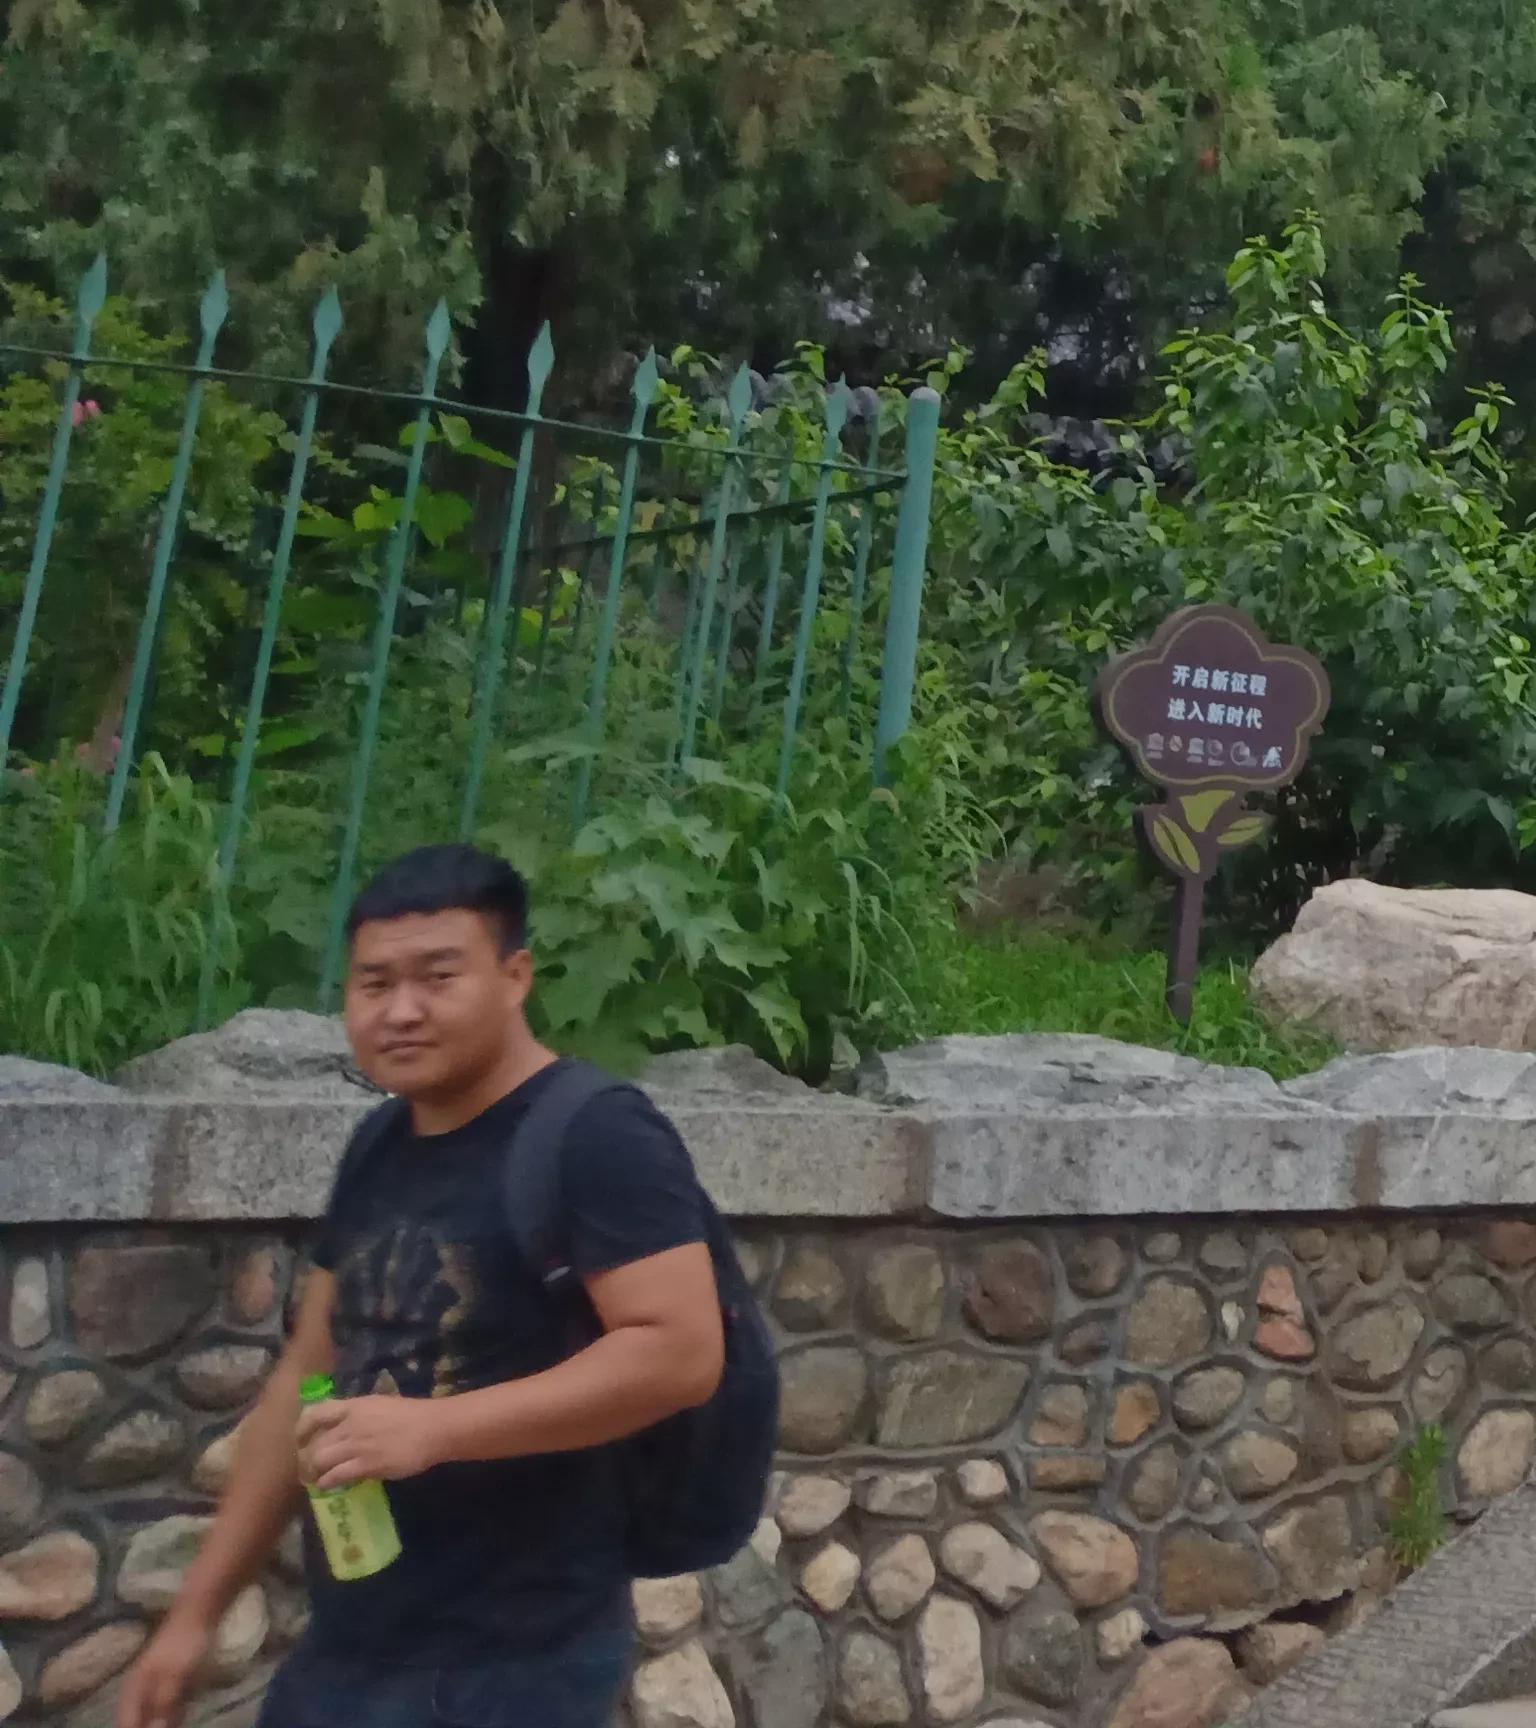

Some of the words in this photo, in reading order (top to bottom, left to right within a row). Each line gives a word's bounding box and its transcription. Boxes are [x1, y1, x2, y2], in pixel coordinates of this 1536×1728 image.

[1172, 664, 1267, 696] 开启新征程
[1167, 697, 1263, 730] 进入新时代
